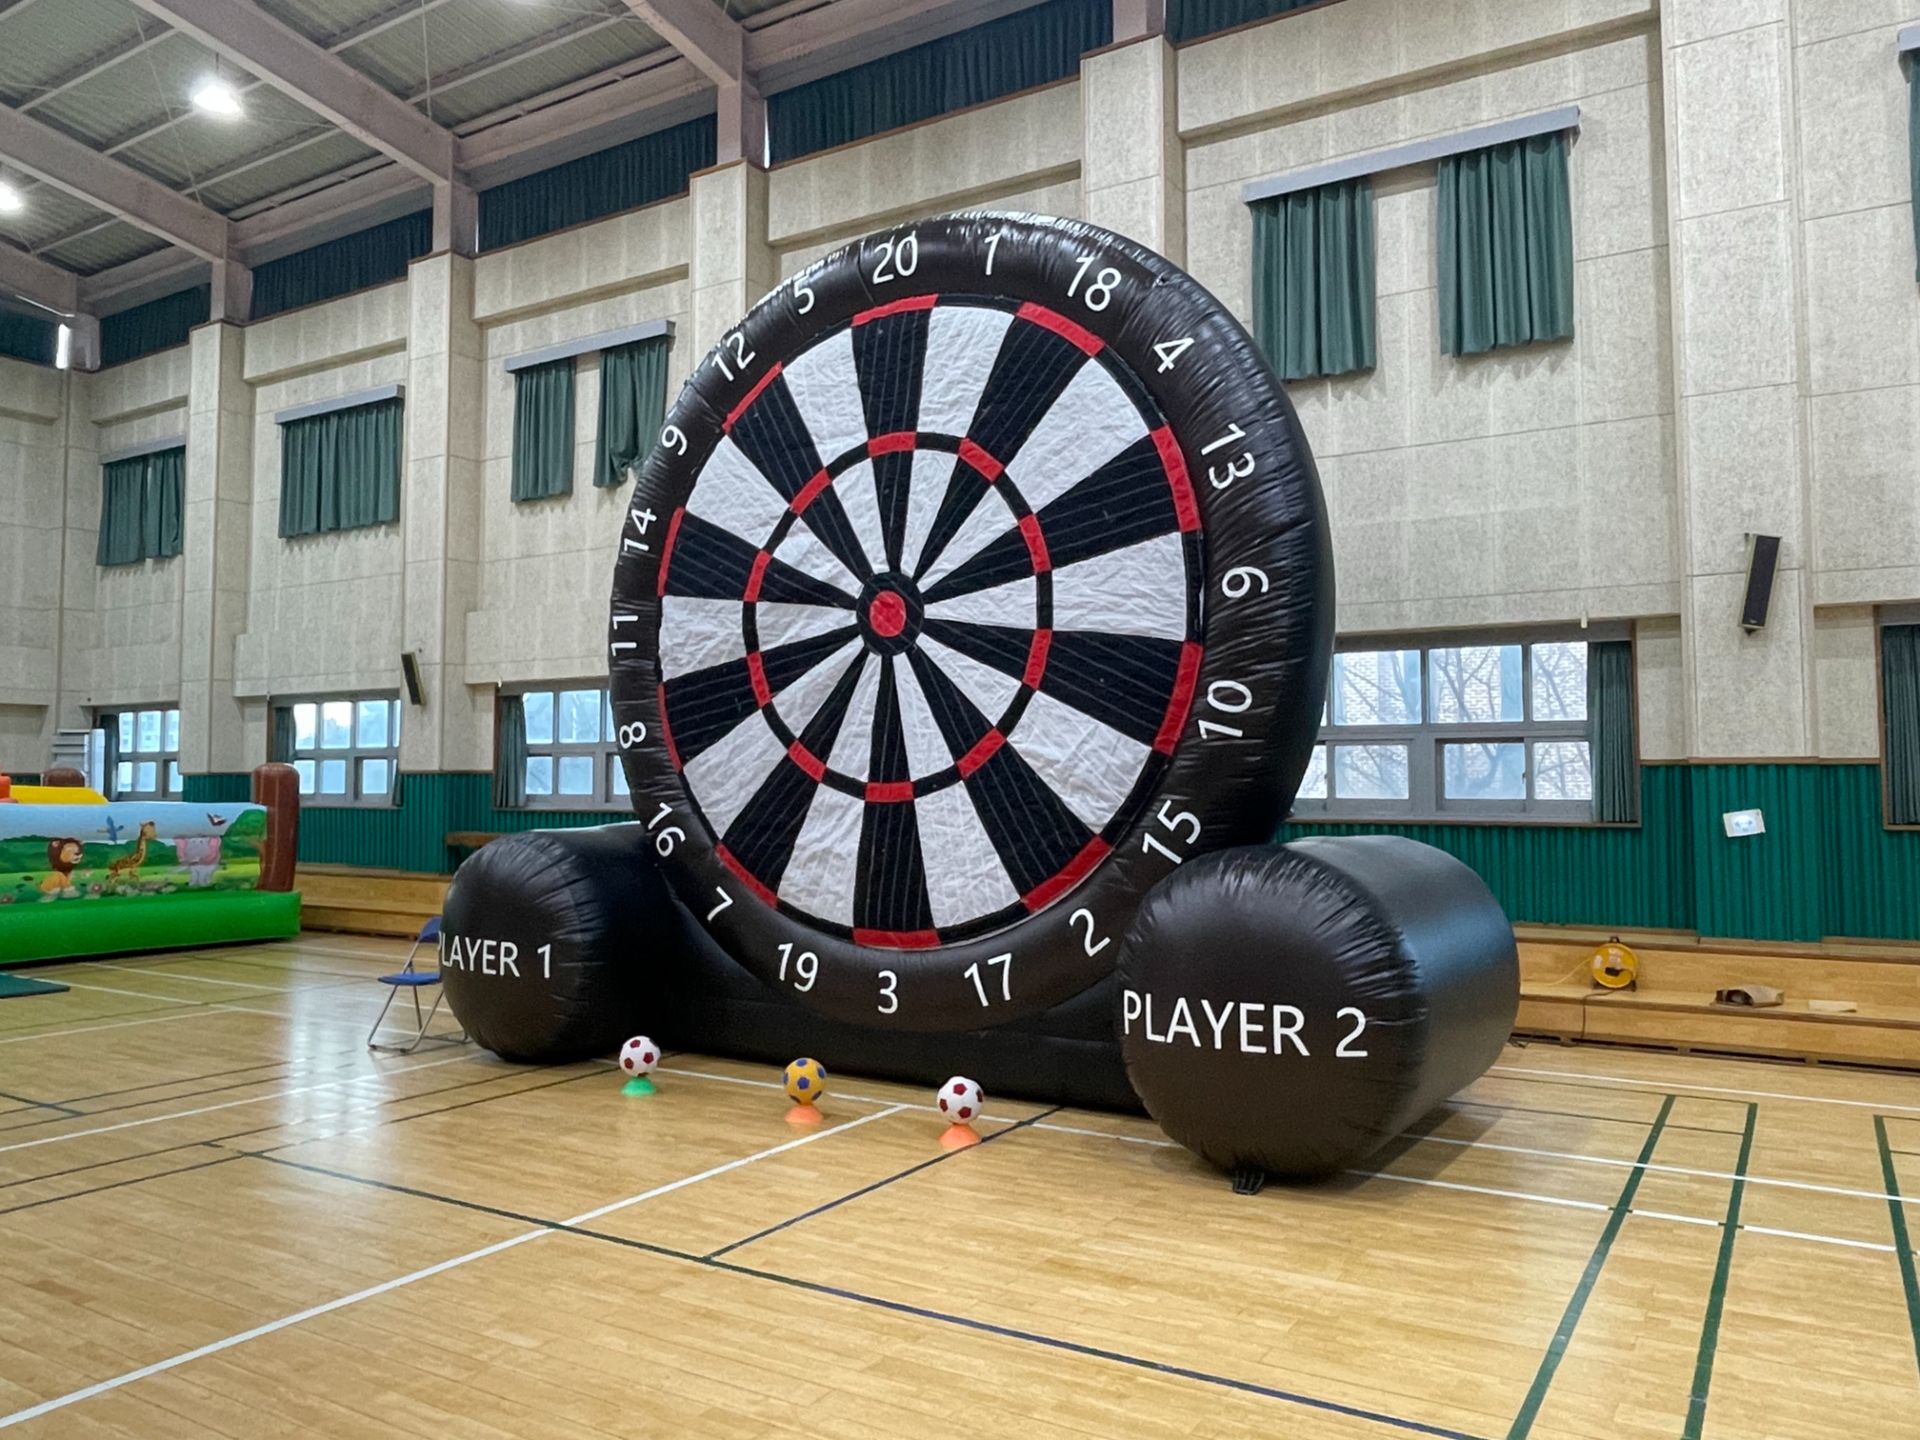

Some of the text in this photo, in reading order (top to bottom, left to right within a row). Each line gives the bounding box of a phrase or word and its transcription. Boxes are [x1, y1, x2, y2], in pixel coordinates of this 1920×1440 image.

[872, 232, 919, 285] 20
[984, 233, 1001, 276] 1
[793, 275, 815, 315] 5
[1066, 254, 1122, 312] 18
[711, 331, 756, 382] 12
[1152, 337, 1192, 374] 4
[661, 424, 688, 456] 9
[1200, 422, 1256, 490] 13
[622, 507, 657, 552] 14
[1221, 566, 1269, 599] 6
[610, 614, 639, 657] 11
[1197, 680, 1253, 740] 10
[619, 721, 647, 749] 8
[647, 802, 686, 857] 16
[1142, 799, 1201, 864] 15
[707, 886, 734, 921] 7
[1069, 908, 1111, 957] 2
[537, 943, 551, 979] 1
[777, 942, 819, 992] 19
[963, 952, 1012, 1007] 17
[877, 970, 898, 1014] 3
[1123, 989, 1368, 1058] PLAYER 2
